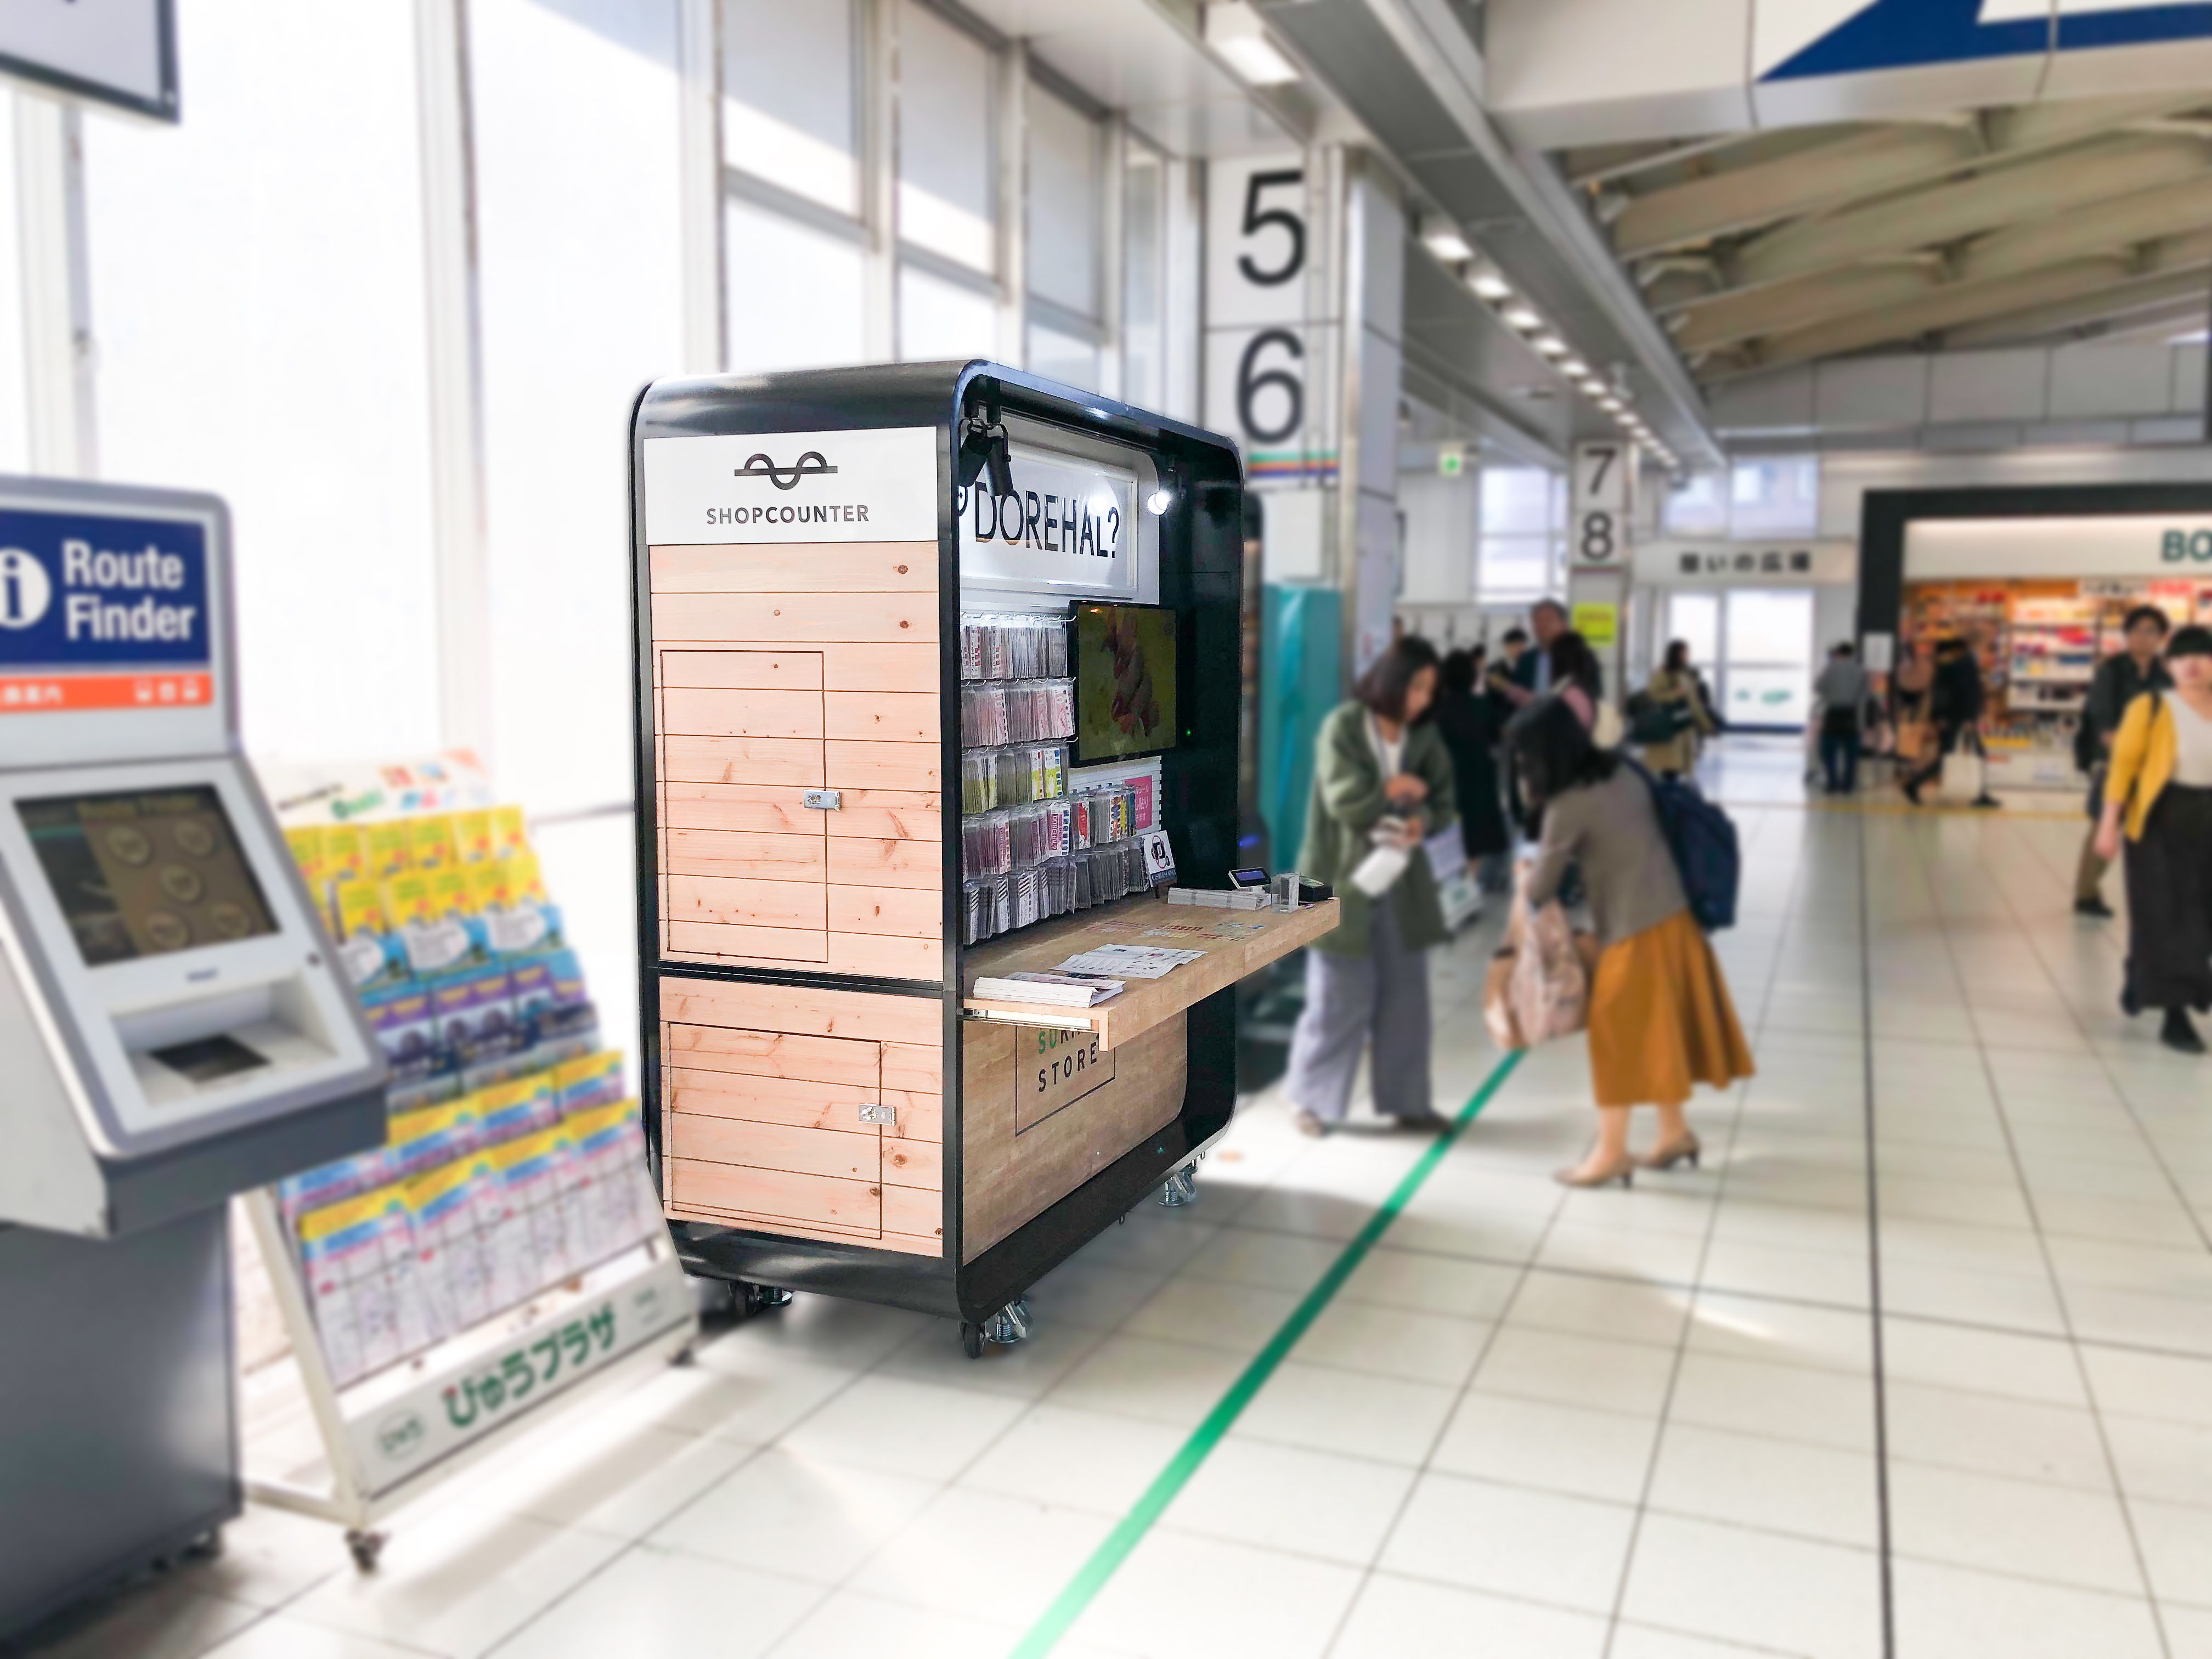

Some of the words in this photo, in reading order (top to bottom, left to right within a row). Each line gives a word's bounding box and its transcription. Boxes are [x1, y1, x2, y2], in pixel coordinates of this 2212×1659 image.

[1237, 169, 1307, 288] 5
[1235, 328, 1304, 445] 6
[1585, 448, 1616, 495] 7
[707, 504, 870, 525] SHOPCOUNTER
[975, 481, 1119, 558] DOREHAL?
[1581, 510, 1613, 562] 8
[63, 539, 185, 590] Route
[66, 594, 196, 641] Finder
[1038, 1041, 1097, 1092] STORE
